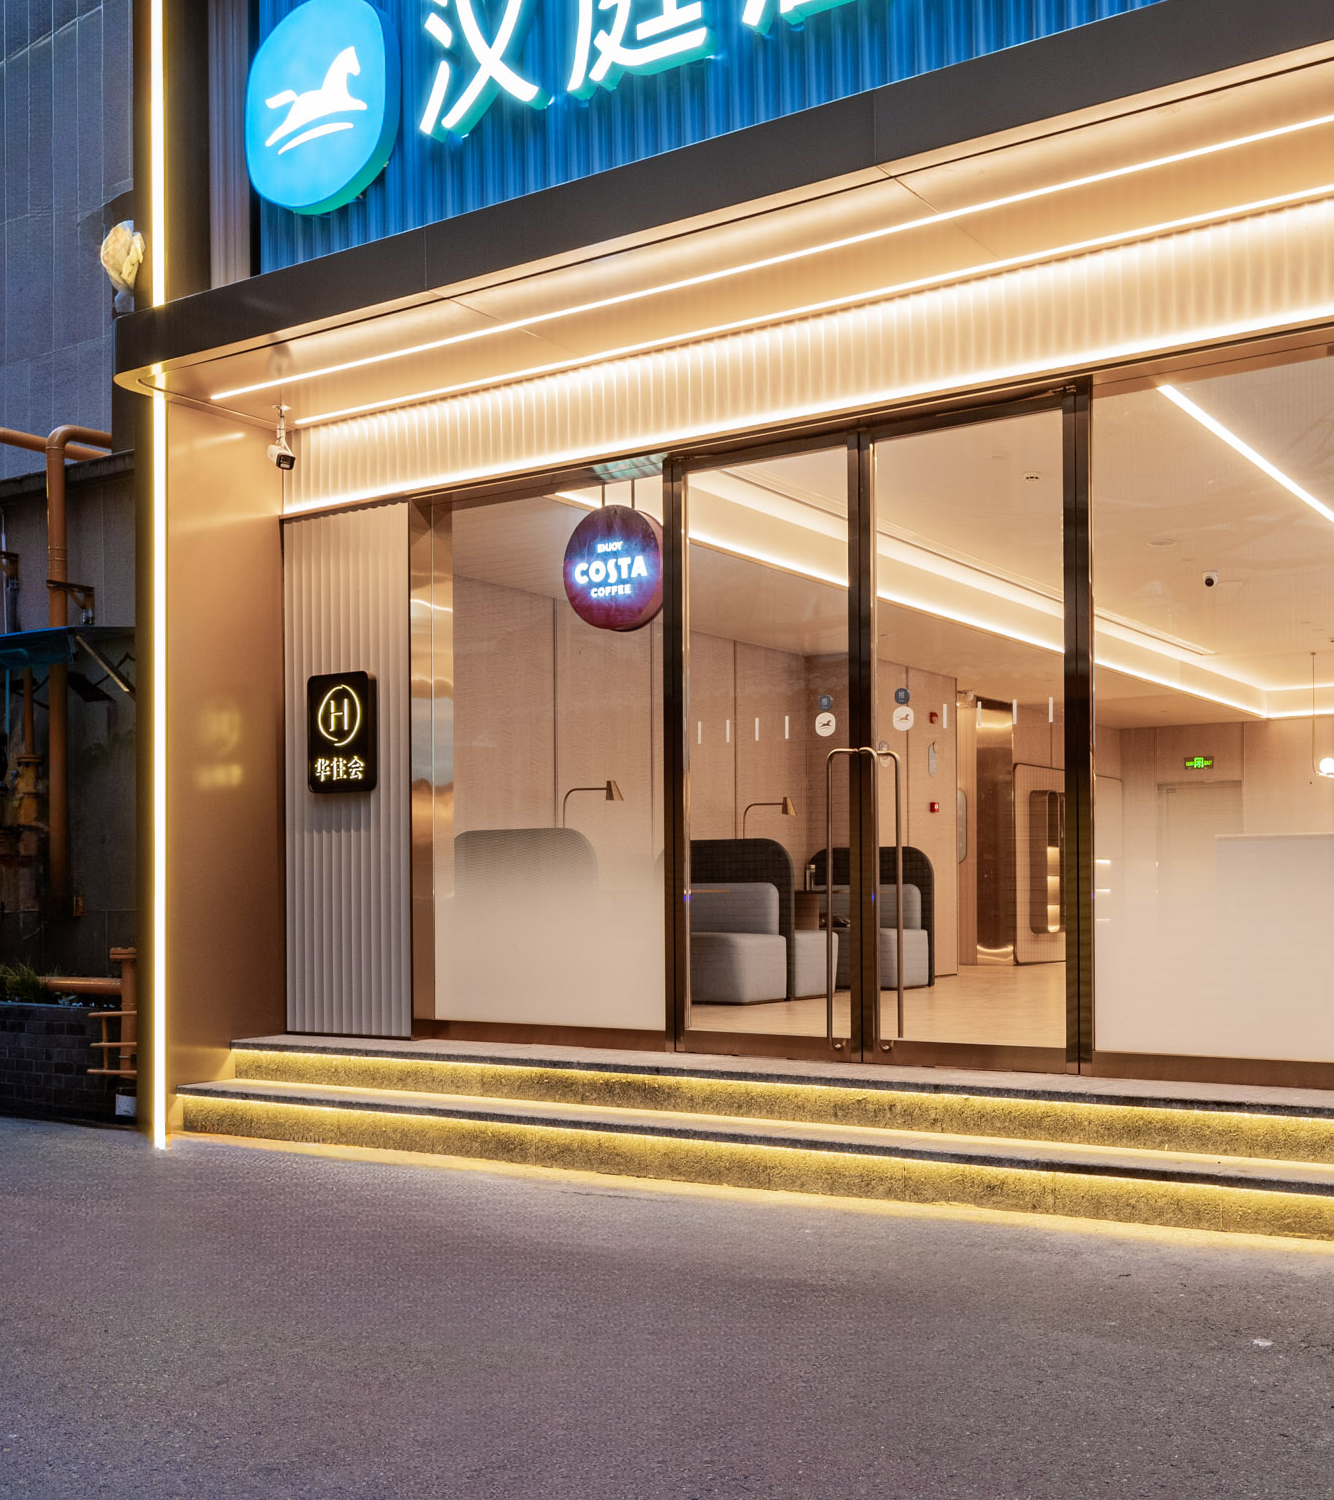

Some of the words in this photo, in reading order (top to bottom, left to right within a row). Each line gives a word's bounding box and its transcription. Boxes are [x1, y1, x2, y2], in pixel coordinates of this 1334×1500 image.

[596, 540, 623, 553] ENJOY
[574, 555, 648, 584] COSTA
[590, 584, 632, 598] COFFEE
[315, 755, 364, 781] 华住会
